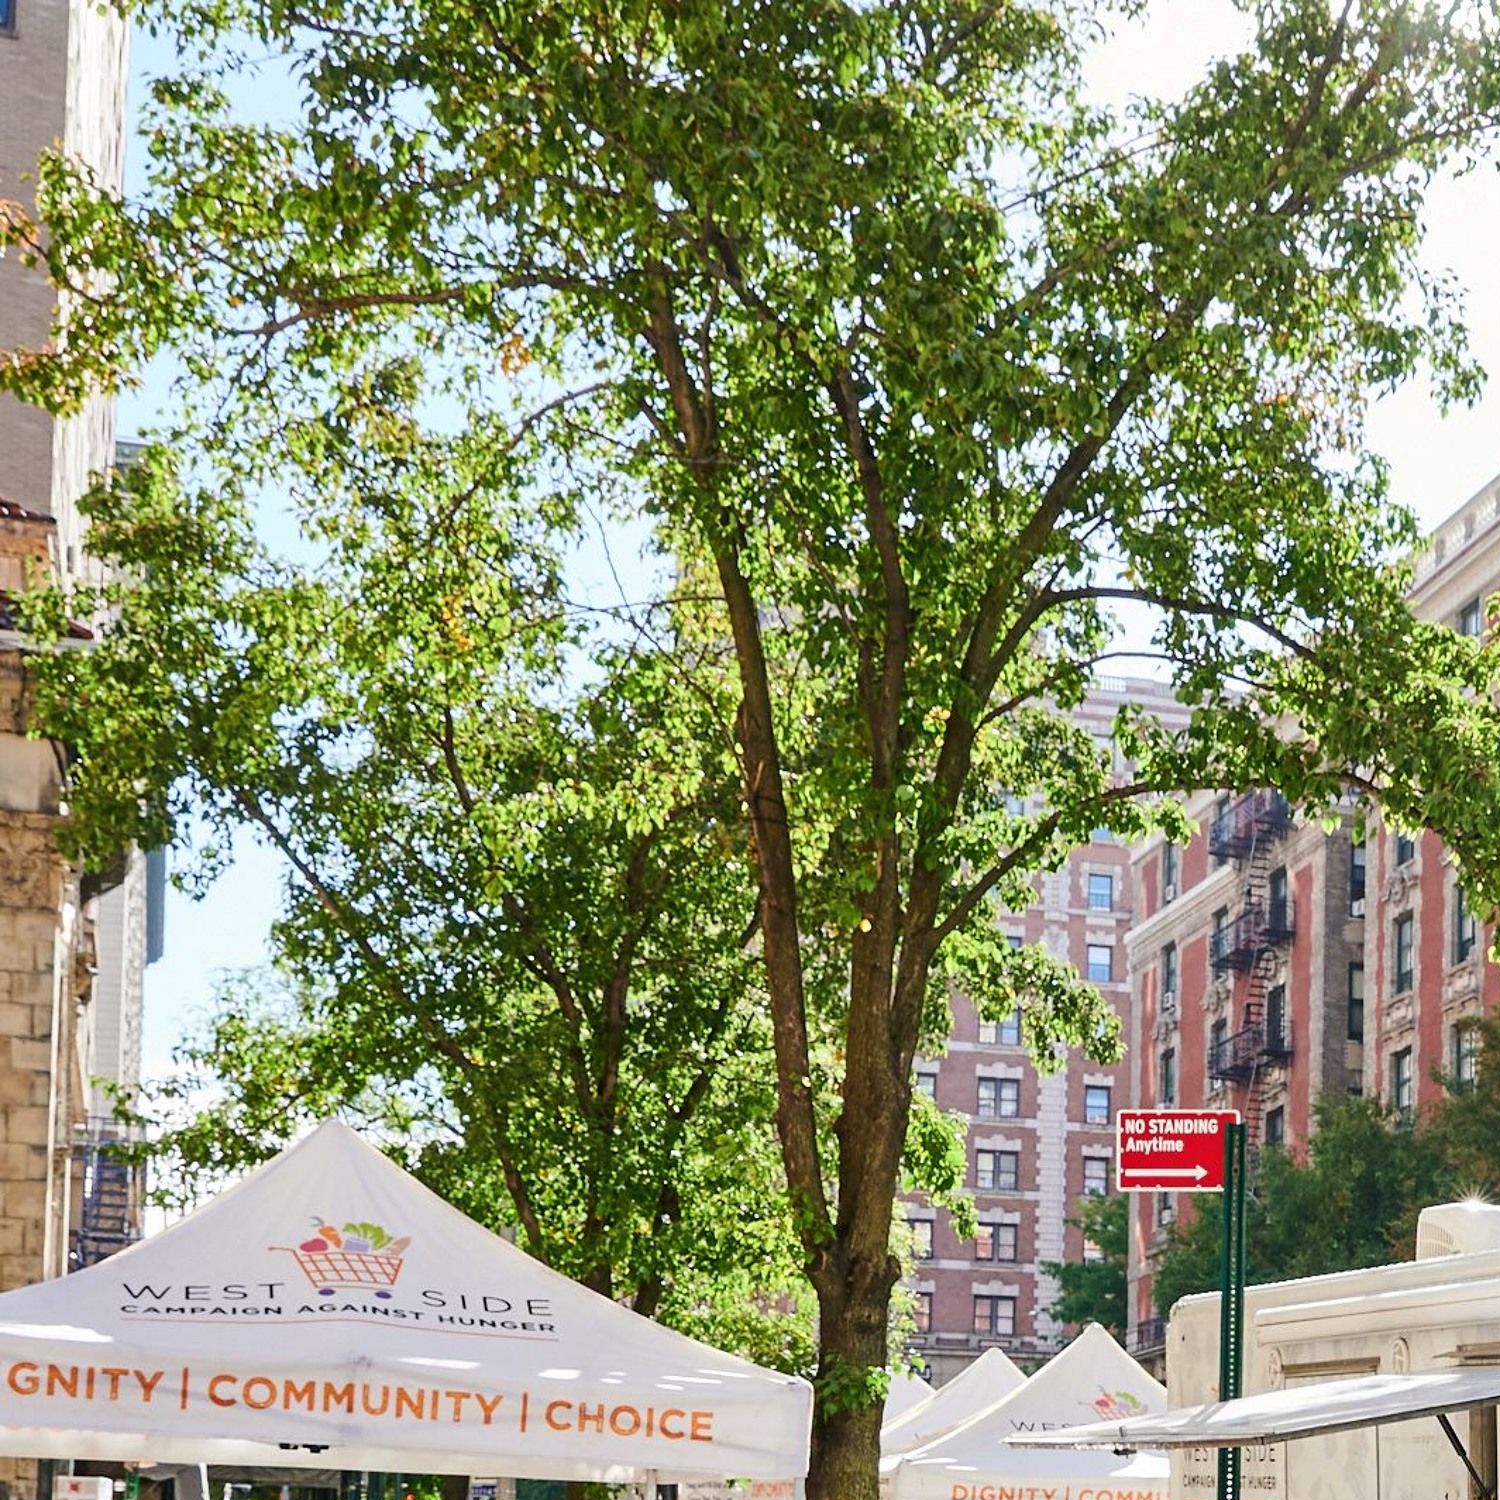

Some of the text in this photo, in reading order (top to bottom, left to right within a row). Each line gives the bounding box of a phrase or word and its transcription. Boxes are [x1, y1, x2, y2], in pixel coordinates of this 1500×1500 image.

[1125, 1119, 1218, 1134] NO STANDING
[1126, 1137, 1184, 1155] Anytime
[122, 1283, 552, 1316] WEST SIDE
[121, 1303, 556, 1332] CAMPAIGN AGAINST HUNGER
[0, 1361, 714, 1441] GNITY COMMUNITY CHOICE
[1183, 1474, 1216, 1488] CAMPAIGN
